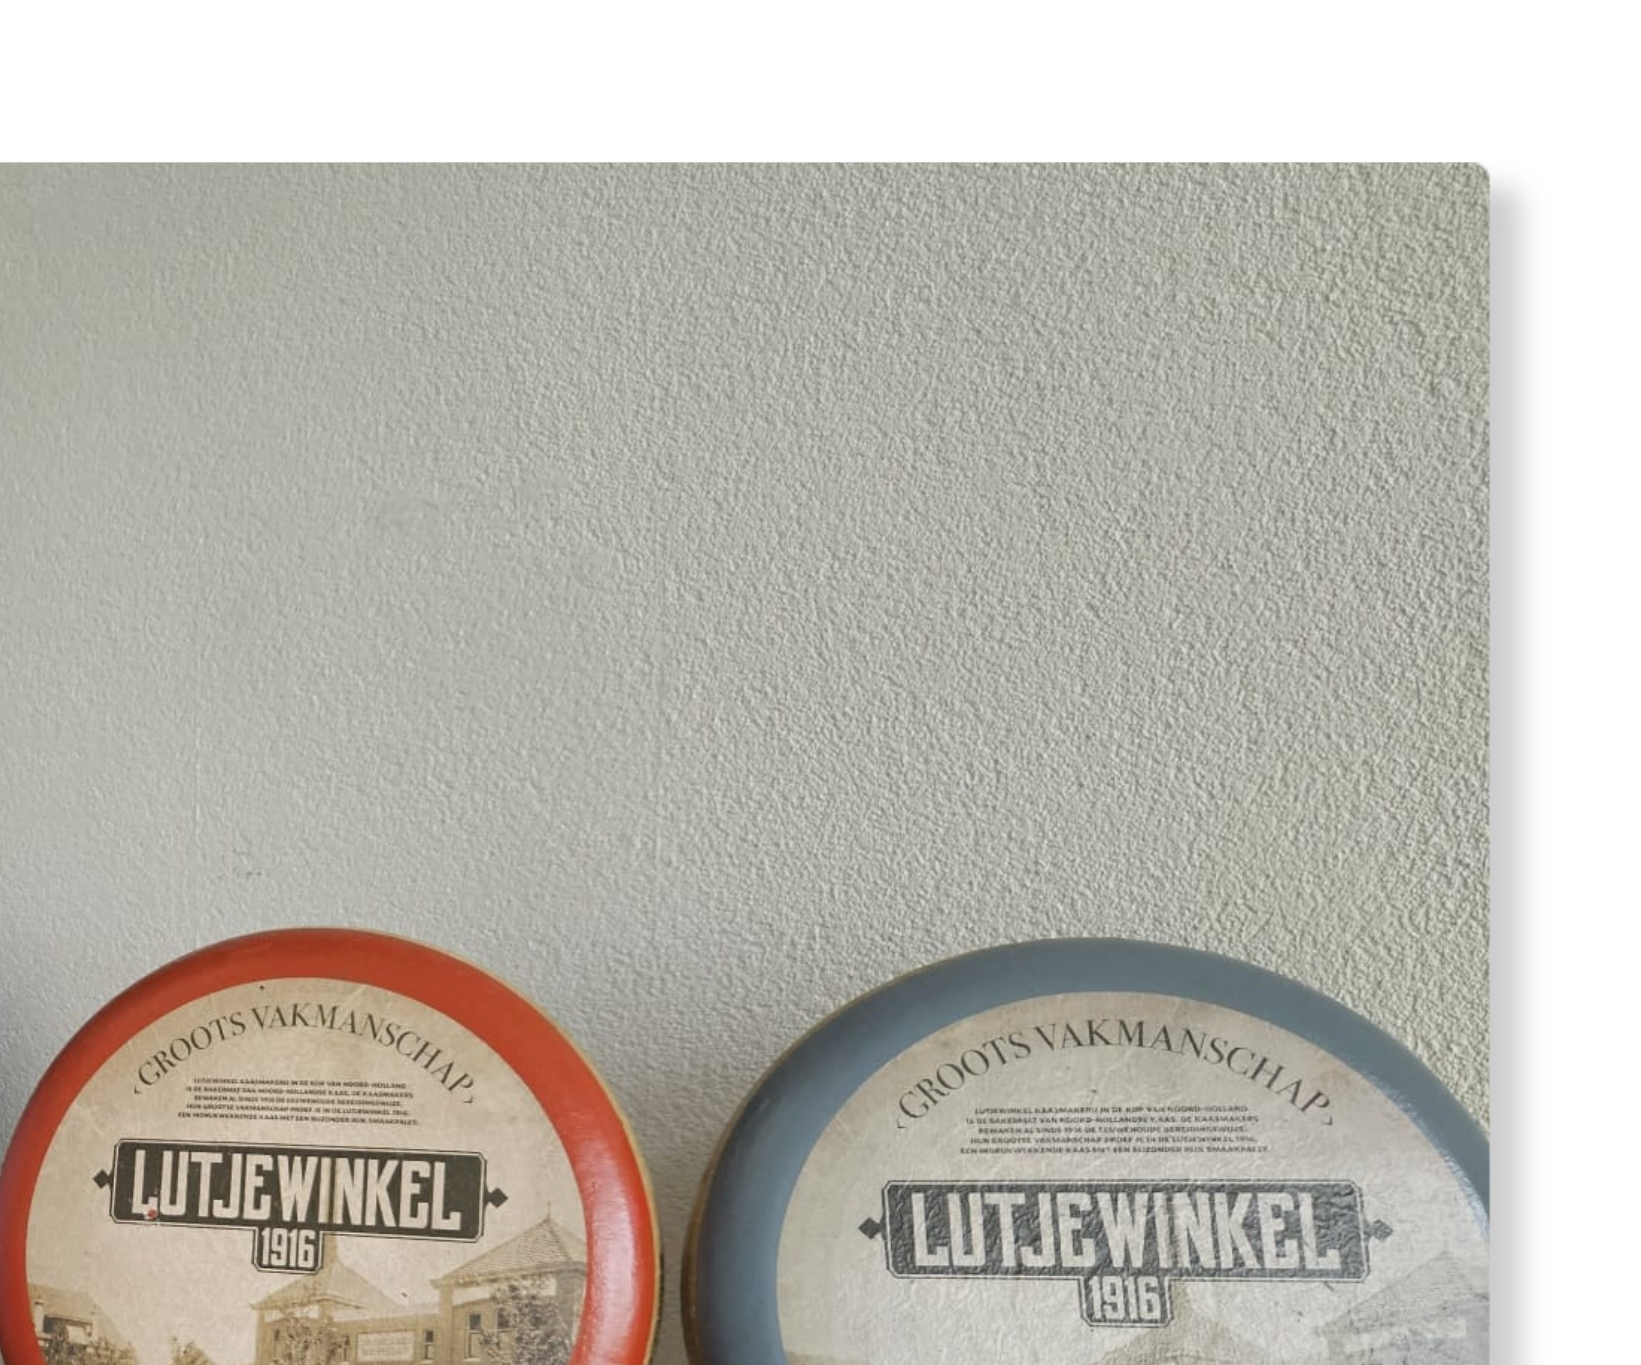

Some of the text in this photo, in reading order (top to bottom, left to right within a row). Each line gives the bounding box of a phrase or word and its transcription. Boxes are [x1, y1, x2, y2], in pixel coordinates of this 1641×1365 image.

[137, 1002, 475, 1095] GROOTS VAKMANSCHAP
[898, 1018, 1331, 1121] GROOTS VAKMANSCHAP
[131, 1149, 462, 1231] LUTJEWINKEL
[260, 1227, 316, 1268] 1916
[911, 1191, 1341, 1271] LUTJEWINKEL
[1087, 1276, 1160, 1323] 1916
